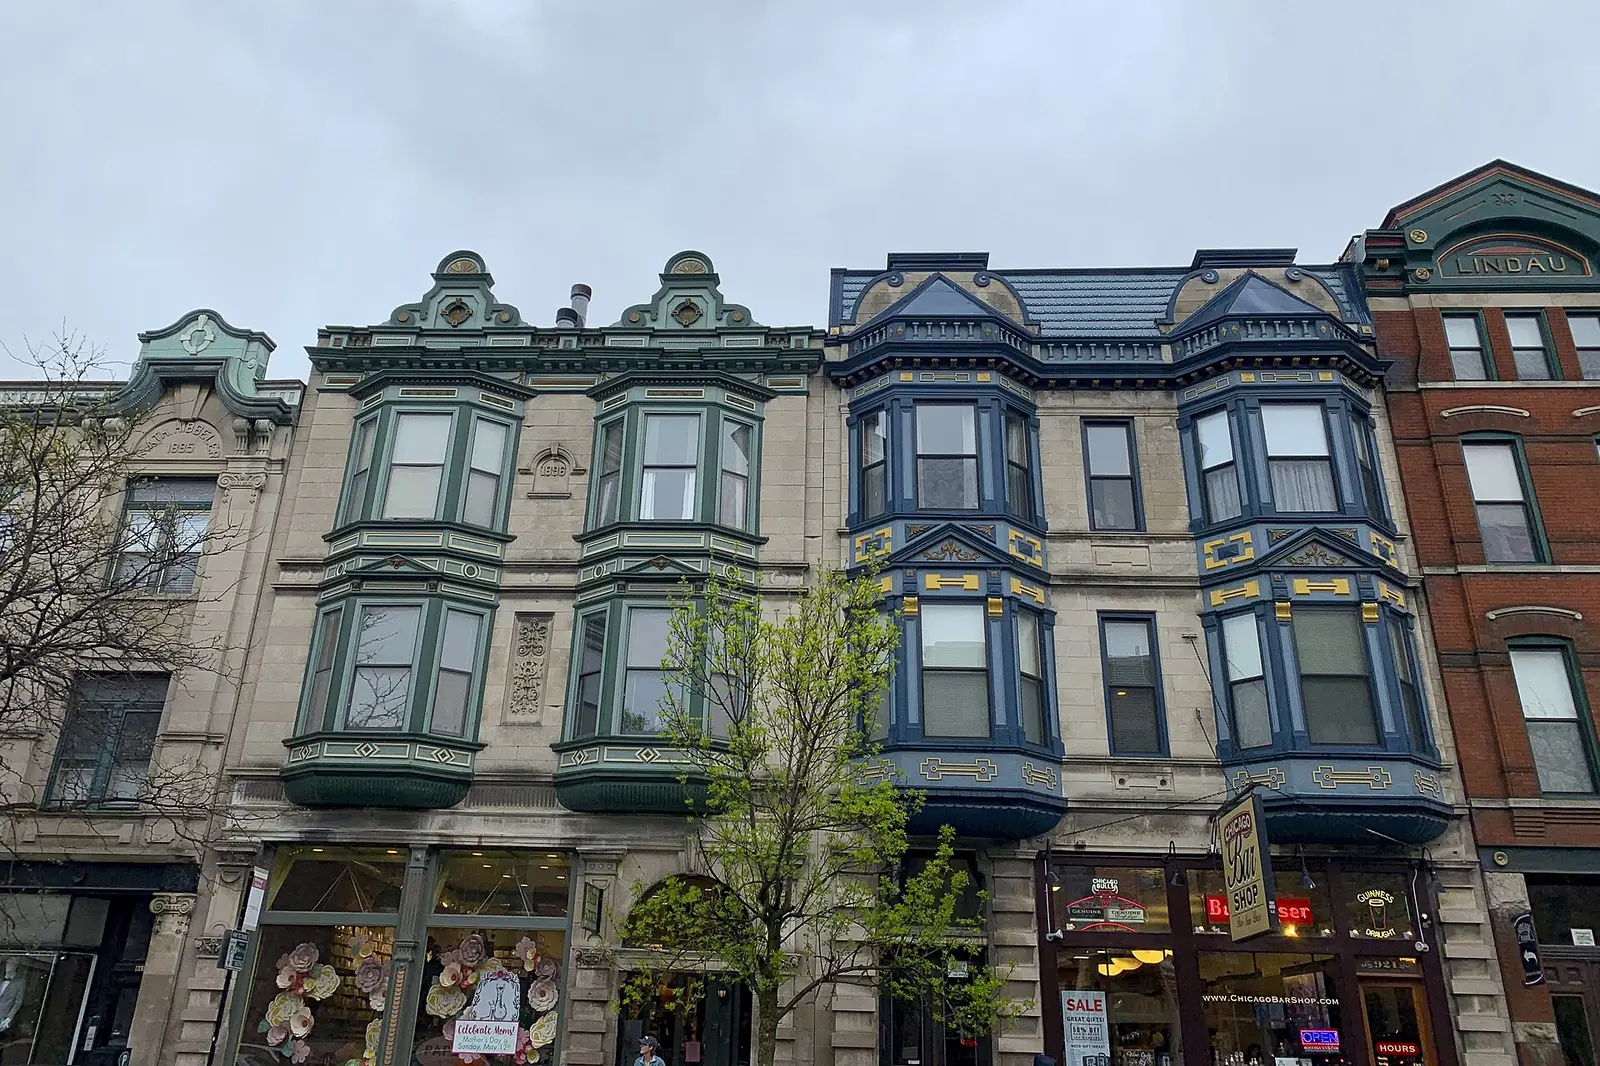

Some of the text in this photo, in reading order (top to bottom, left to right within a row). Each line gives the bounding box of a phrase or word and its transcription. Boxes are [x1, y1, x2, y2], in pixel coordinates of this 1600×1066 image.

[1457, 256, 1567, 274] LINDAU
[167, 443, 195, 454] 1895
[540, 466, 567, 477] 1896
[1224, 814, 1251, 841] CHICAGO
[1227, 834, 1257, 889] Bar
[1096, 882, 1114, 890] BULLS
[1234, 884, 1259, 912] SHOP
[1356, 889, 1395, 904] GUINNESS
[1365, 928, 1397, 938] DRAUGHT
[1066, 998, 1103, 1012] SALE
[457, 1024, 516, 1036] Celebrate Moms!
[489, 1036, 502, 1044] Day
[1303, 1032, 1338, 1043] OPEN
[483, 1044, 498, 1052] May
[1379, 1044, 1416, 1053] HOURS
